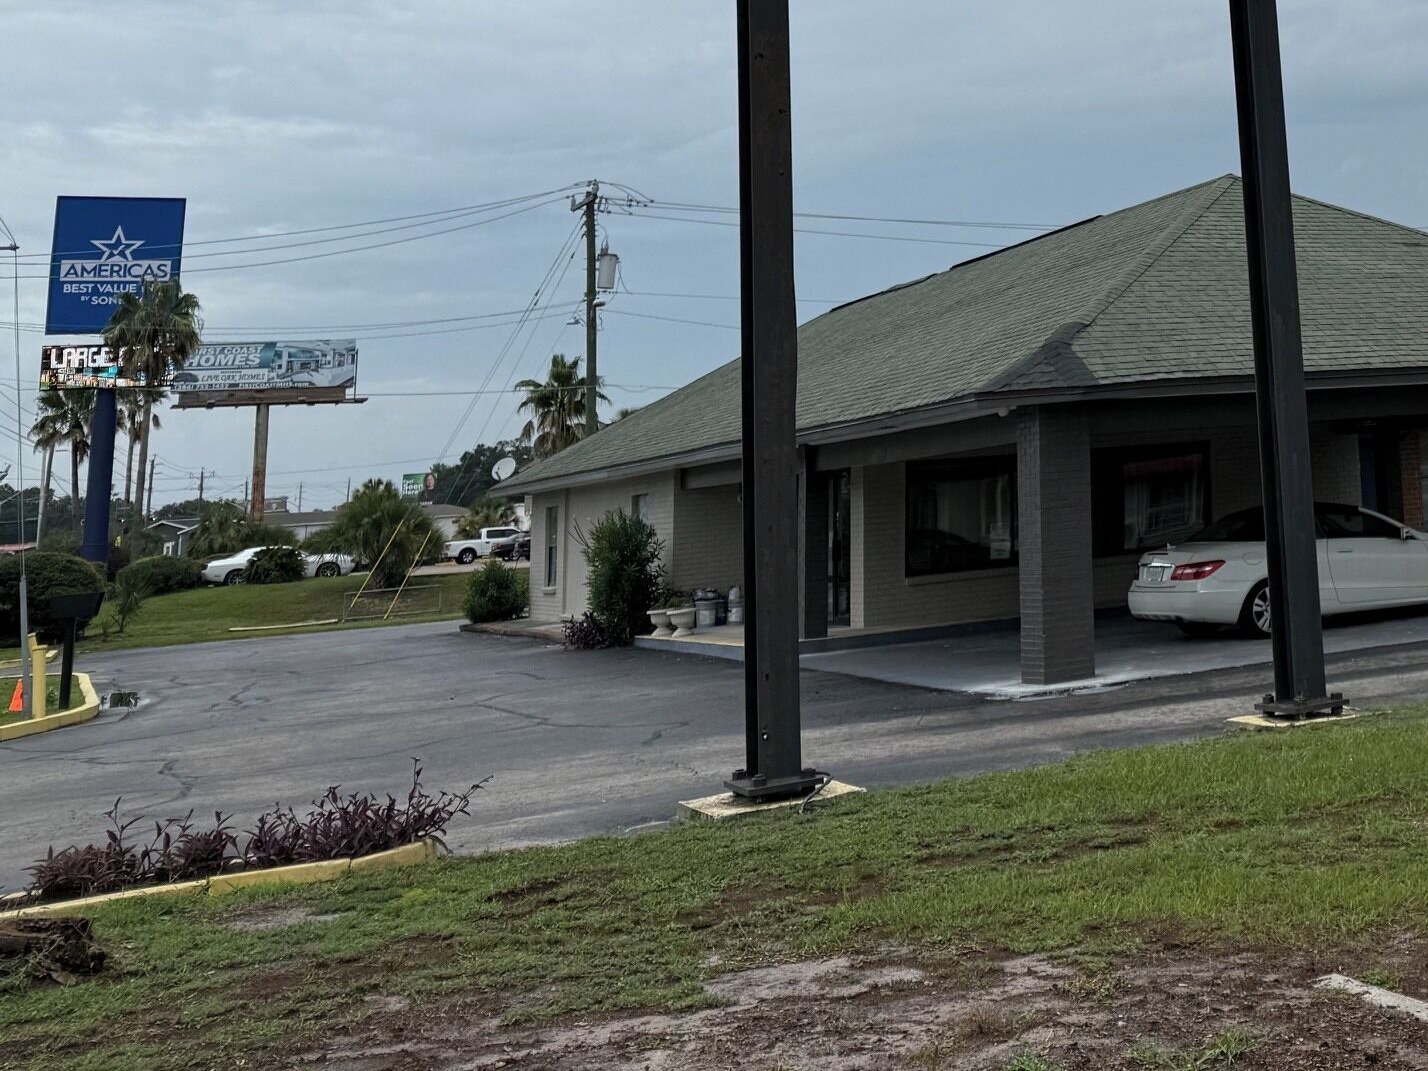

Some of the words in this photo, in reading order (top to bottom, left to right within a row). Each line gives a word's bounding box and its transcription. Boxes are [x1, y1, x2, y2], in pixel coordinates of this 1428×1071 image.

[64, 264, 168, 278] AMERICAS
[63, 284, 94, 294] BEST
[97, 283, 137, 293] VALUE
[224, 345, 262, 354] COAST
[184, 353, 260, 366] HOMES
